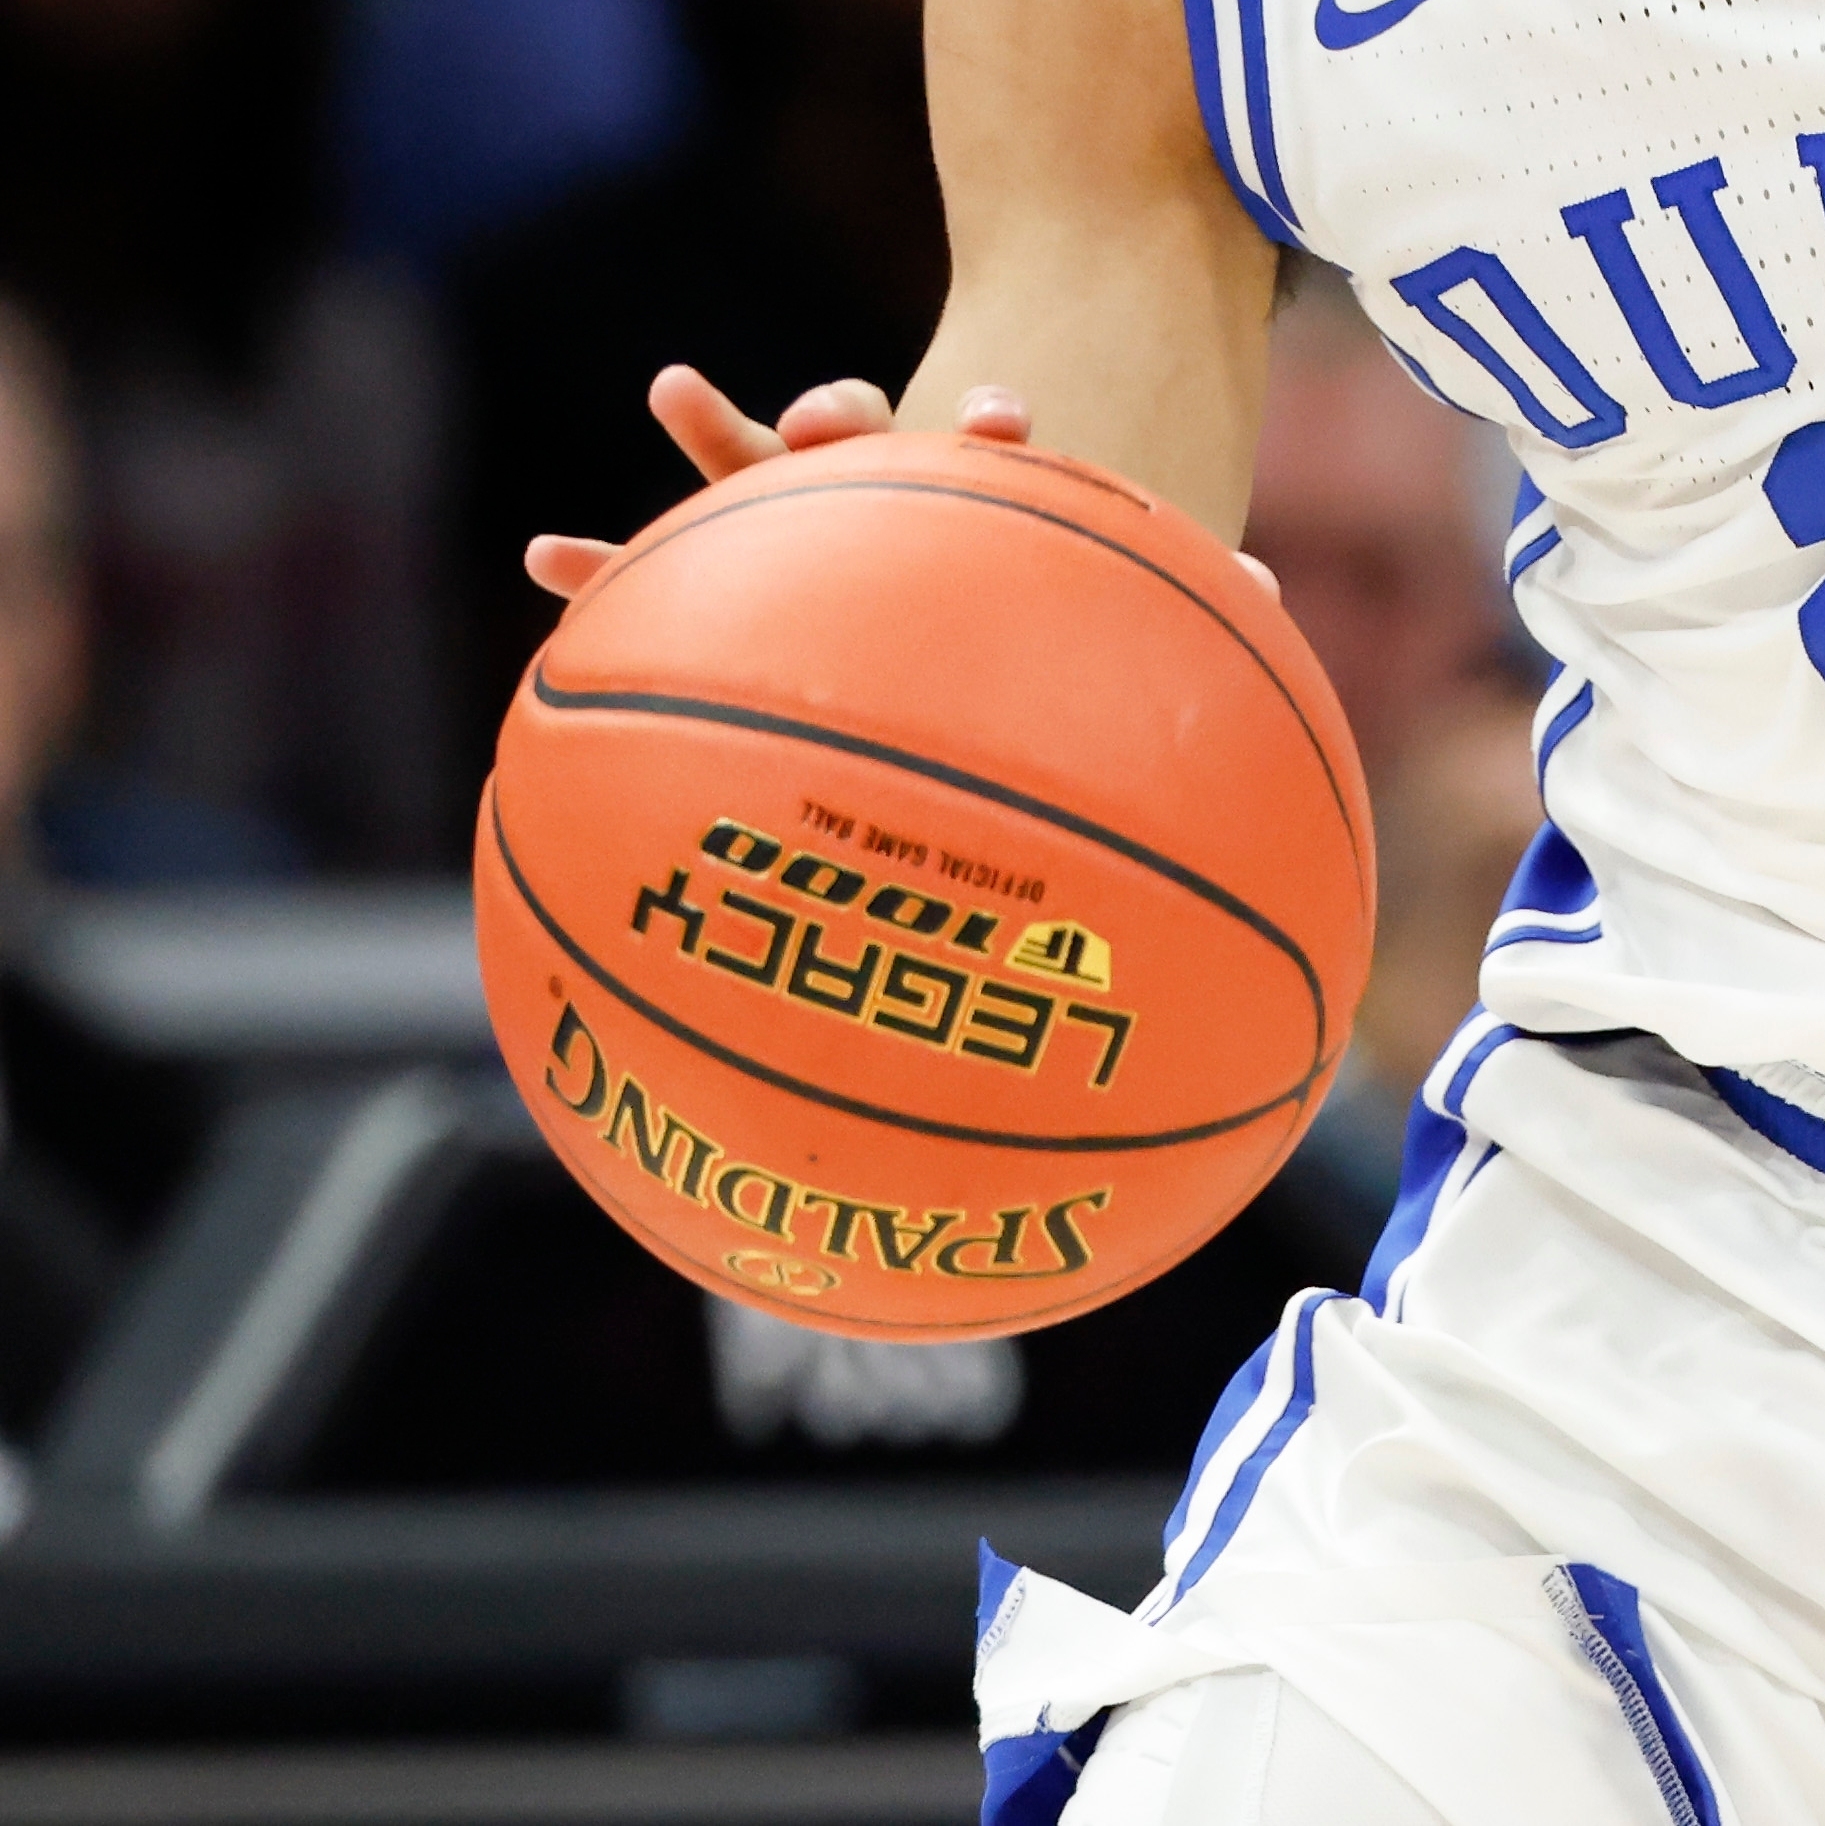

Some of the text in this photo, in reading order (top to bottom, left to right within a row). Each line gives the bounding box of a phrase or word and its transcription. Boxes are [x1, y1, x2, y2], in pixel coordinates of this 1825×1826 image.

[698, 816, 1000, 955] 1000
[800, 798, 1046, 904] OFFICIAL GAME BALL
[629, 867, 1138, 1091] LEGACY
[545, 1000, 1113, 1280] SPALDING
